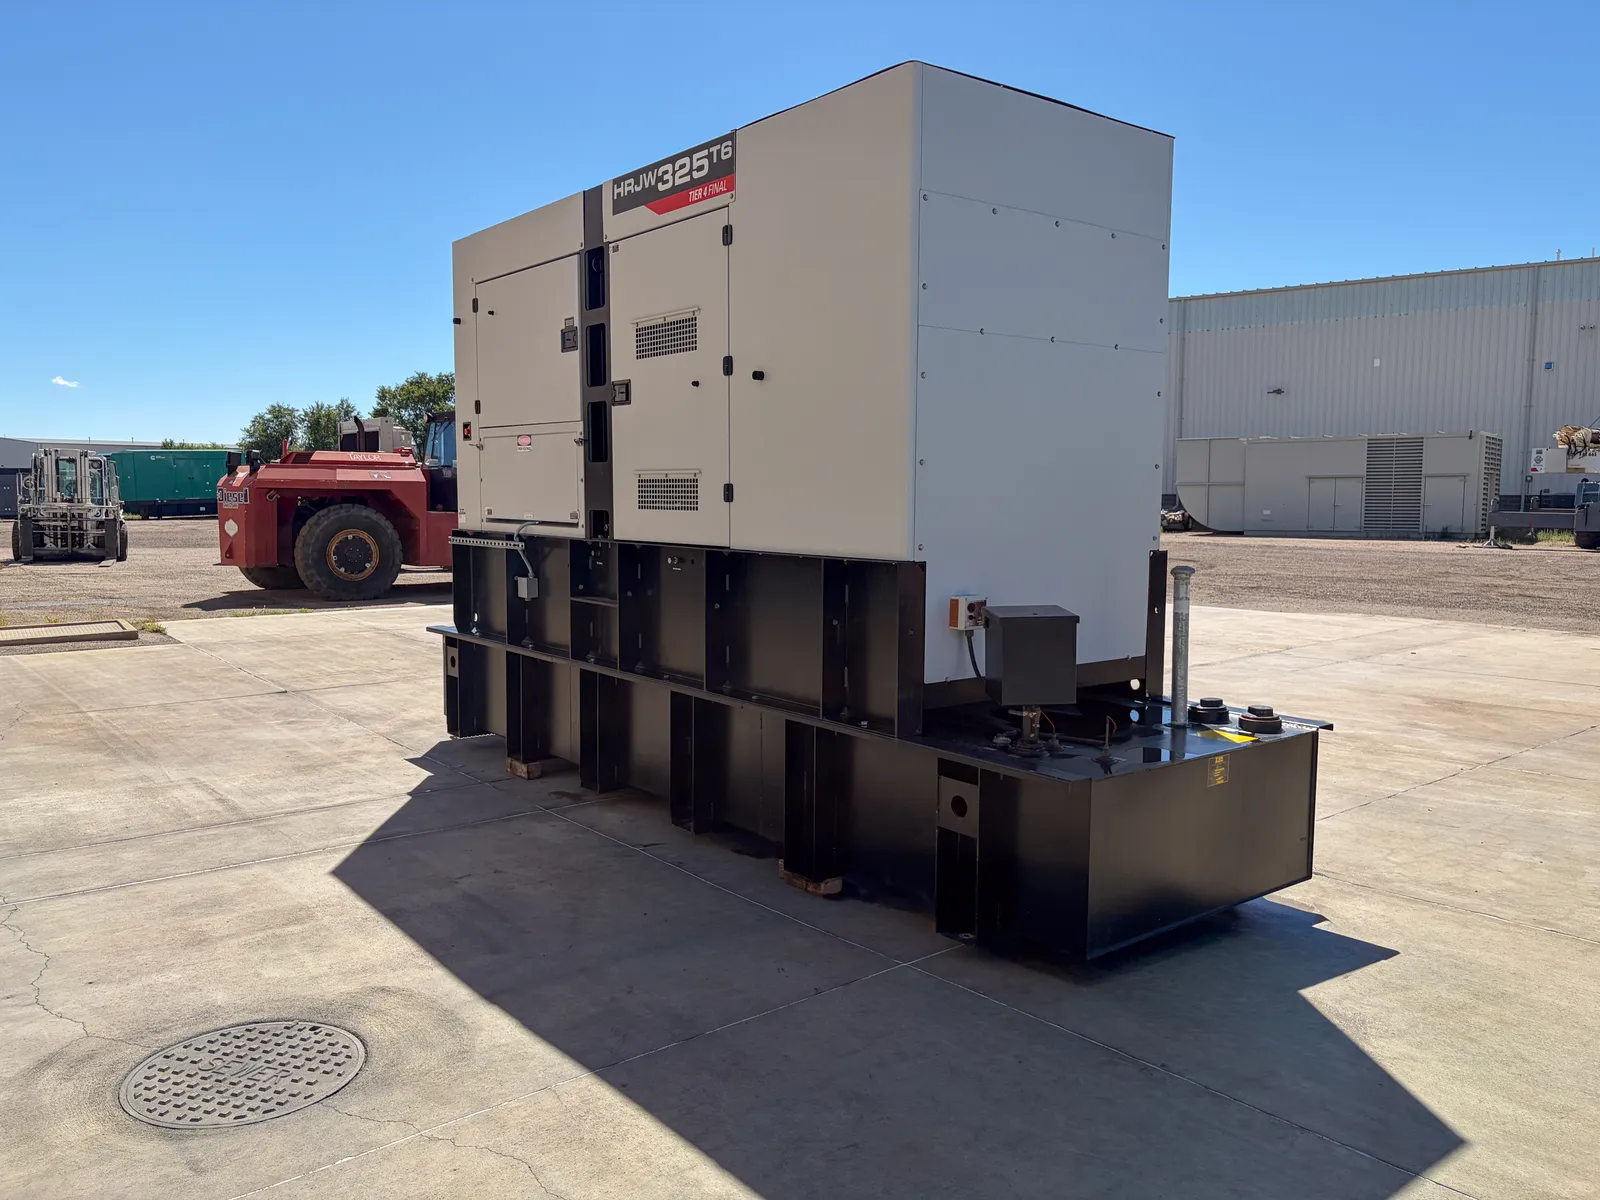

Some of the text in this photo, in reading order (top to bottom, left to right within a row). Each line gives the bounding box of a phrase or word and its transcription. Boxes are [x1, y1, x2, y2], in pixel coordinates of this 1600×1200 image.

[688, 179, 728, 202] TIER 4 FINAL
[347, 453, 382, 461] TAYLOR
[217, 487, 250, 504] Diesel
[198, 1057, 293, 1085] SEWER
